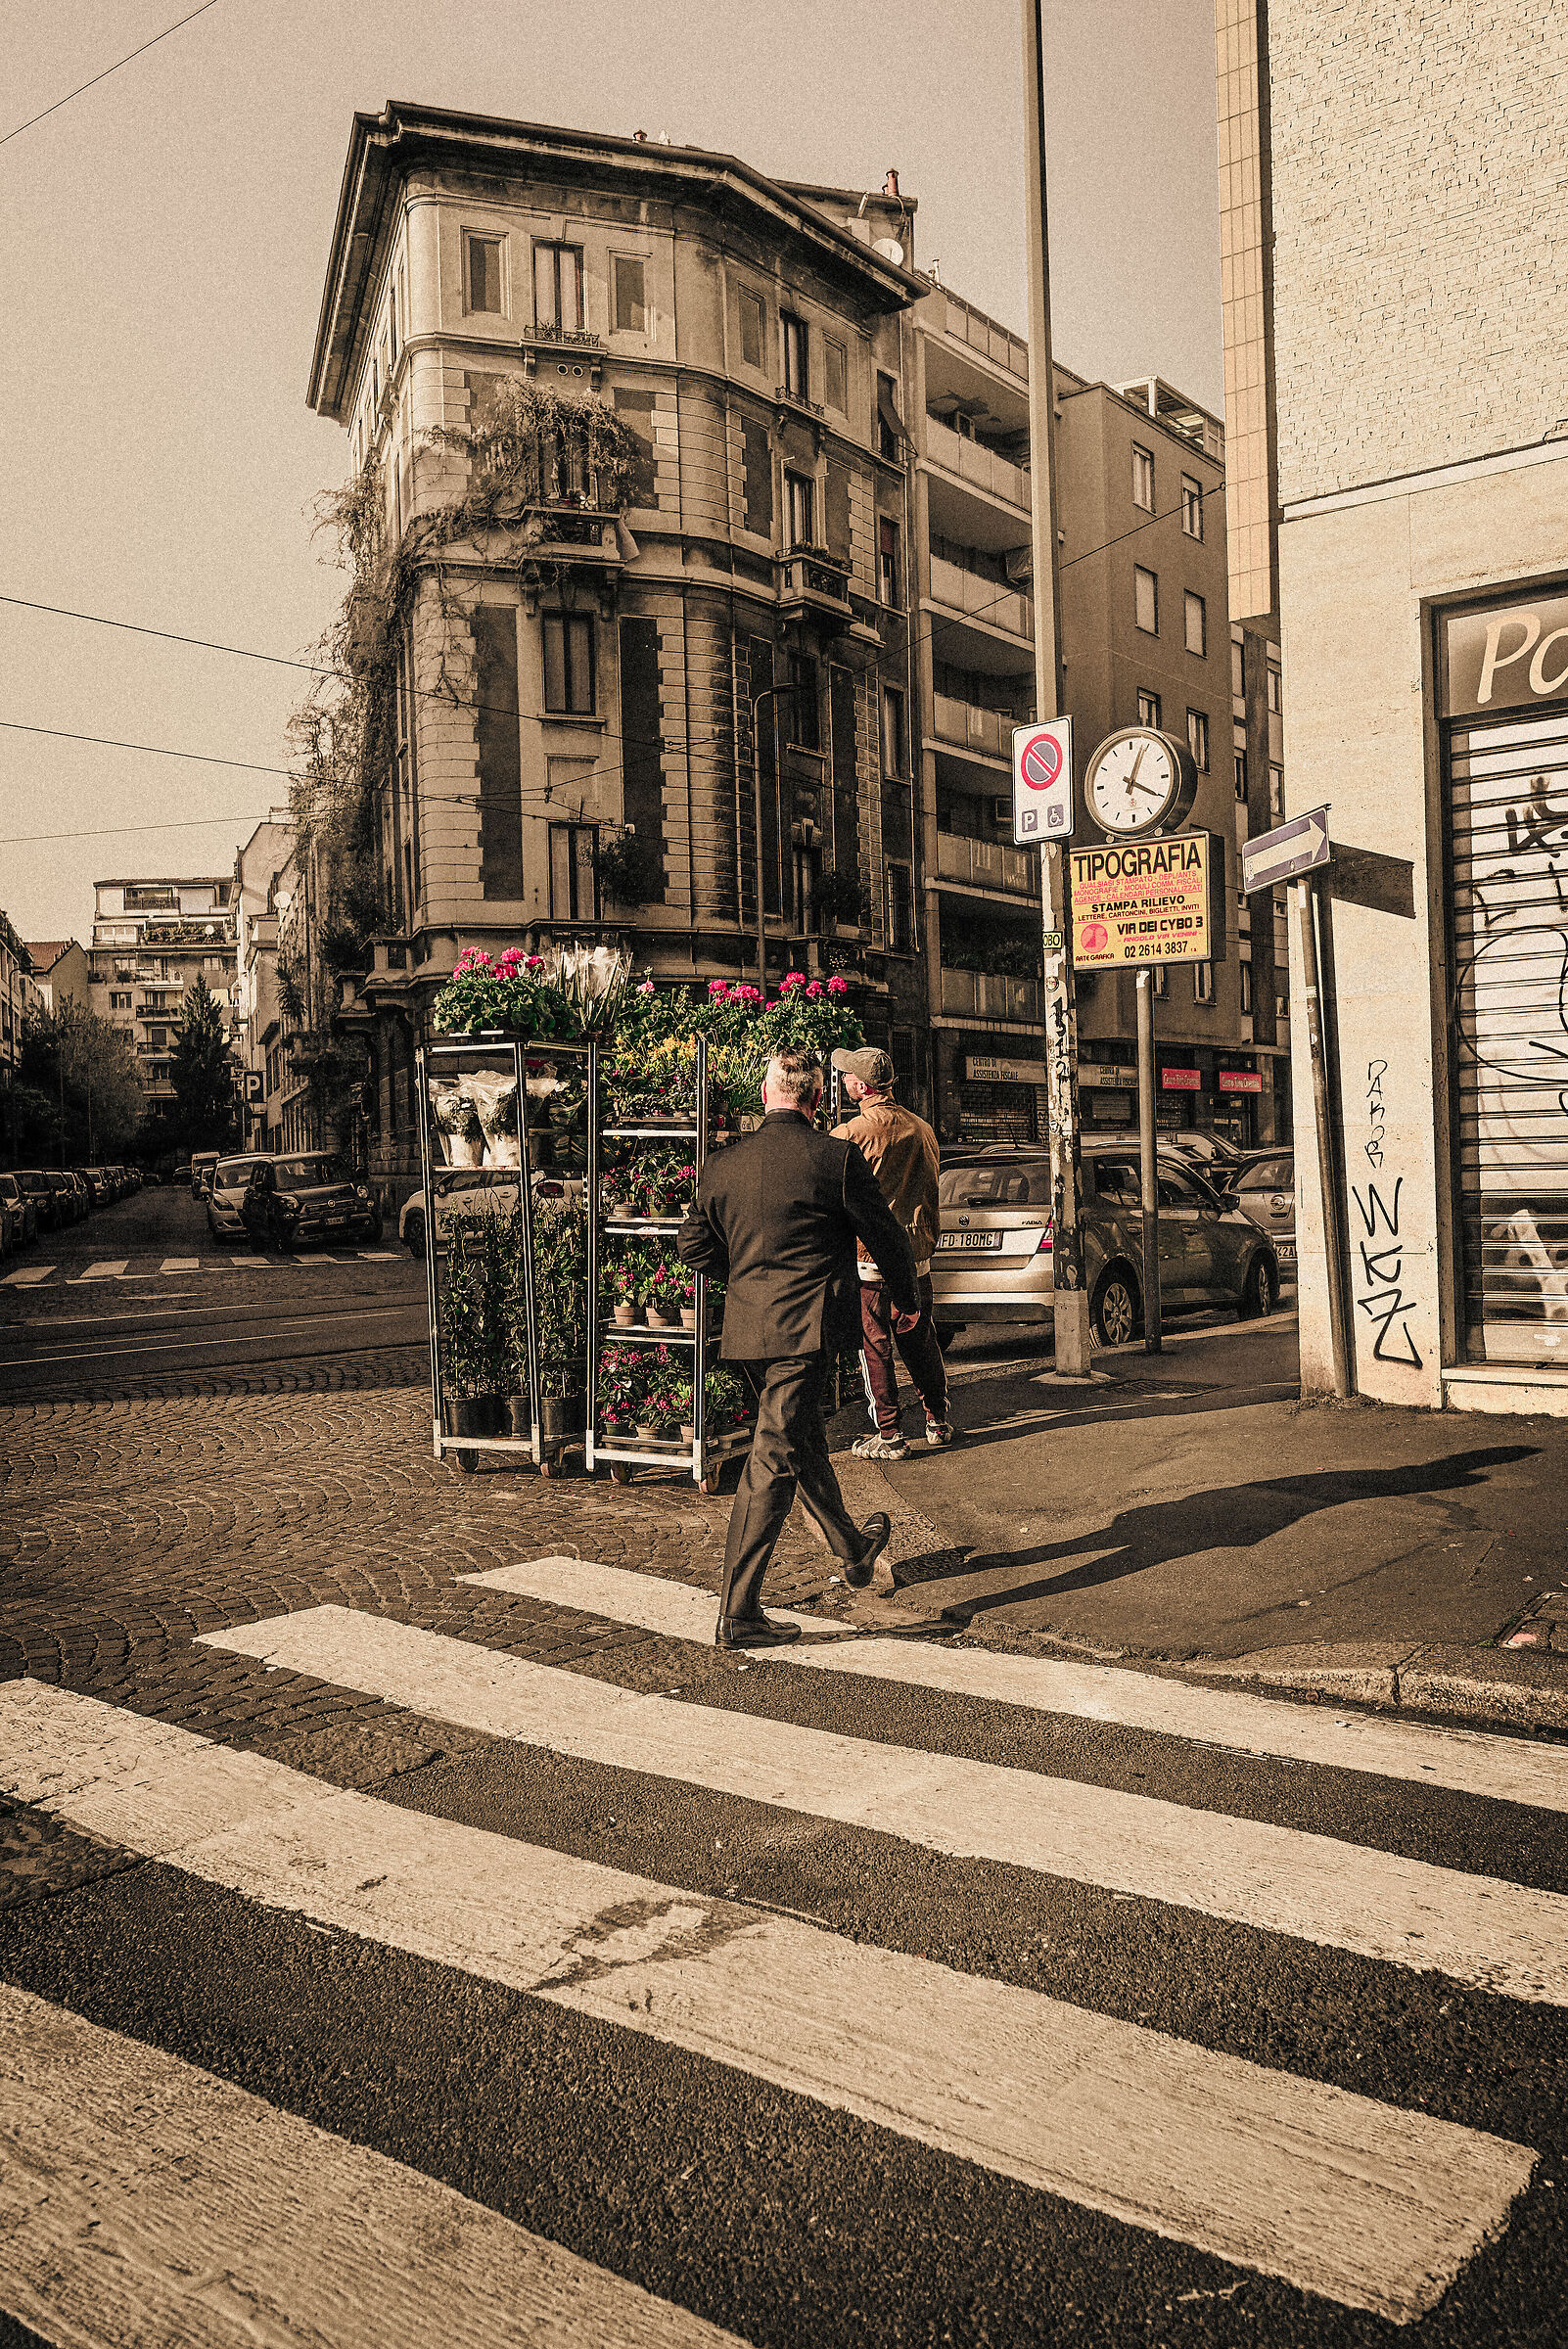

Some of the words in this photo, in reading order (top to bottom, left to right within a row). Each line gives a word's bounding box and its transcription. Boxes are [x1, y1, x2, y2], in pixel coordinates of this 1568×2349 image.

[1024, 811, 1036, 831] P
[1074, 842, 1202, 882] TIPOGRAFIA
[1074, 886, 1118, 896] MONOGRAFIE
[1125, 882, 1149, 892] MODULI
[1080, 880, 1114, 890] QUALSIASI
[1116, 875, 1153, 886] STAMPATO
[1159, 870, 1196, 880] DEPLIANTS
[1075, 895, 1101, 903] AGENDE
[1106, 891, 1144, 900] CALENDARI
[1146, 884, 1202, 896] PERSONALIZZATI
[1091, 900, 1137, 913] STAMPA
[1141, 896, 1184, 907] RILIEVO
[1108, 909, 1147, 919] CARTONCINI,
[1117, 923, 1136, 935] VIA
[1139, 921, 1157, 933] DEI
[1160, 917, 1192, 931] CYBO
[1195, 916, 1203, 928] 3
[1125, 945, 1135, 958] 02
[1139, 944, 1162, 957] 2614
[1165, 941, 1187, 954] 3837
[1000, 1071, 1019, 1081] FISCALE
[247, 1075, 260, 1099] P
[941, 1234, 955, 1247] FD
